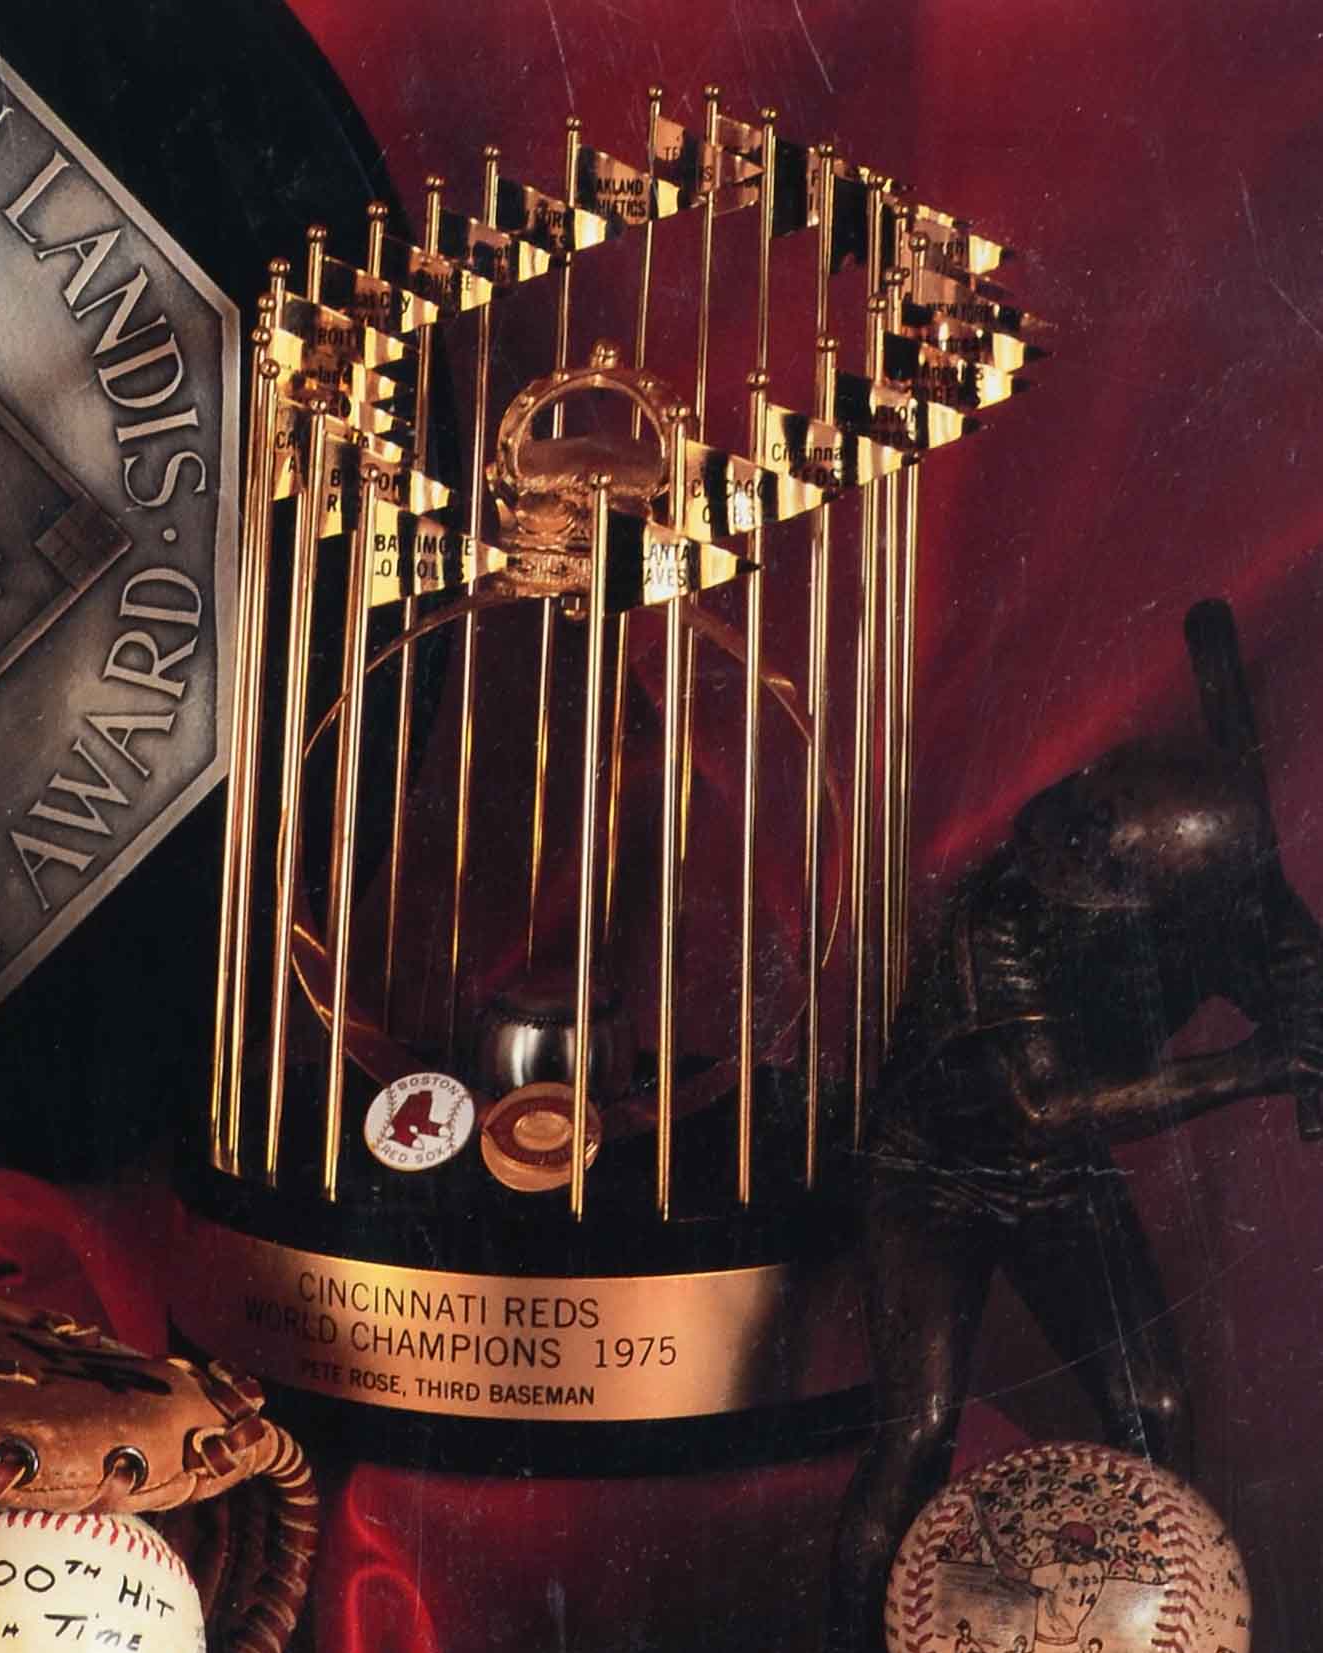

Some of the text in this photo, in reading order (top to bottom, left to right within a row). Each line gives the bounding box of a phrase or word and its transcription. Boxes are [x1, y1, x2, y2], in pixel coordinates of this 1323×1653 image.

[4, 159, 208, 508] LANDIS
[8, 567, 203, 912] AWARD
[397, 1074, 458, 1096] BOSTON
[380, 1145, 445, 1165] RED SOX
[297, 1271, 600, 1330] CINCINNATI REDS
[245, 1300, 677, 1369] WORLD CHAMPIONS 1975
[301, 1360, 595, 1406] PETE ROSE, THIRD BASEMAN
